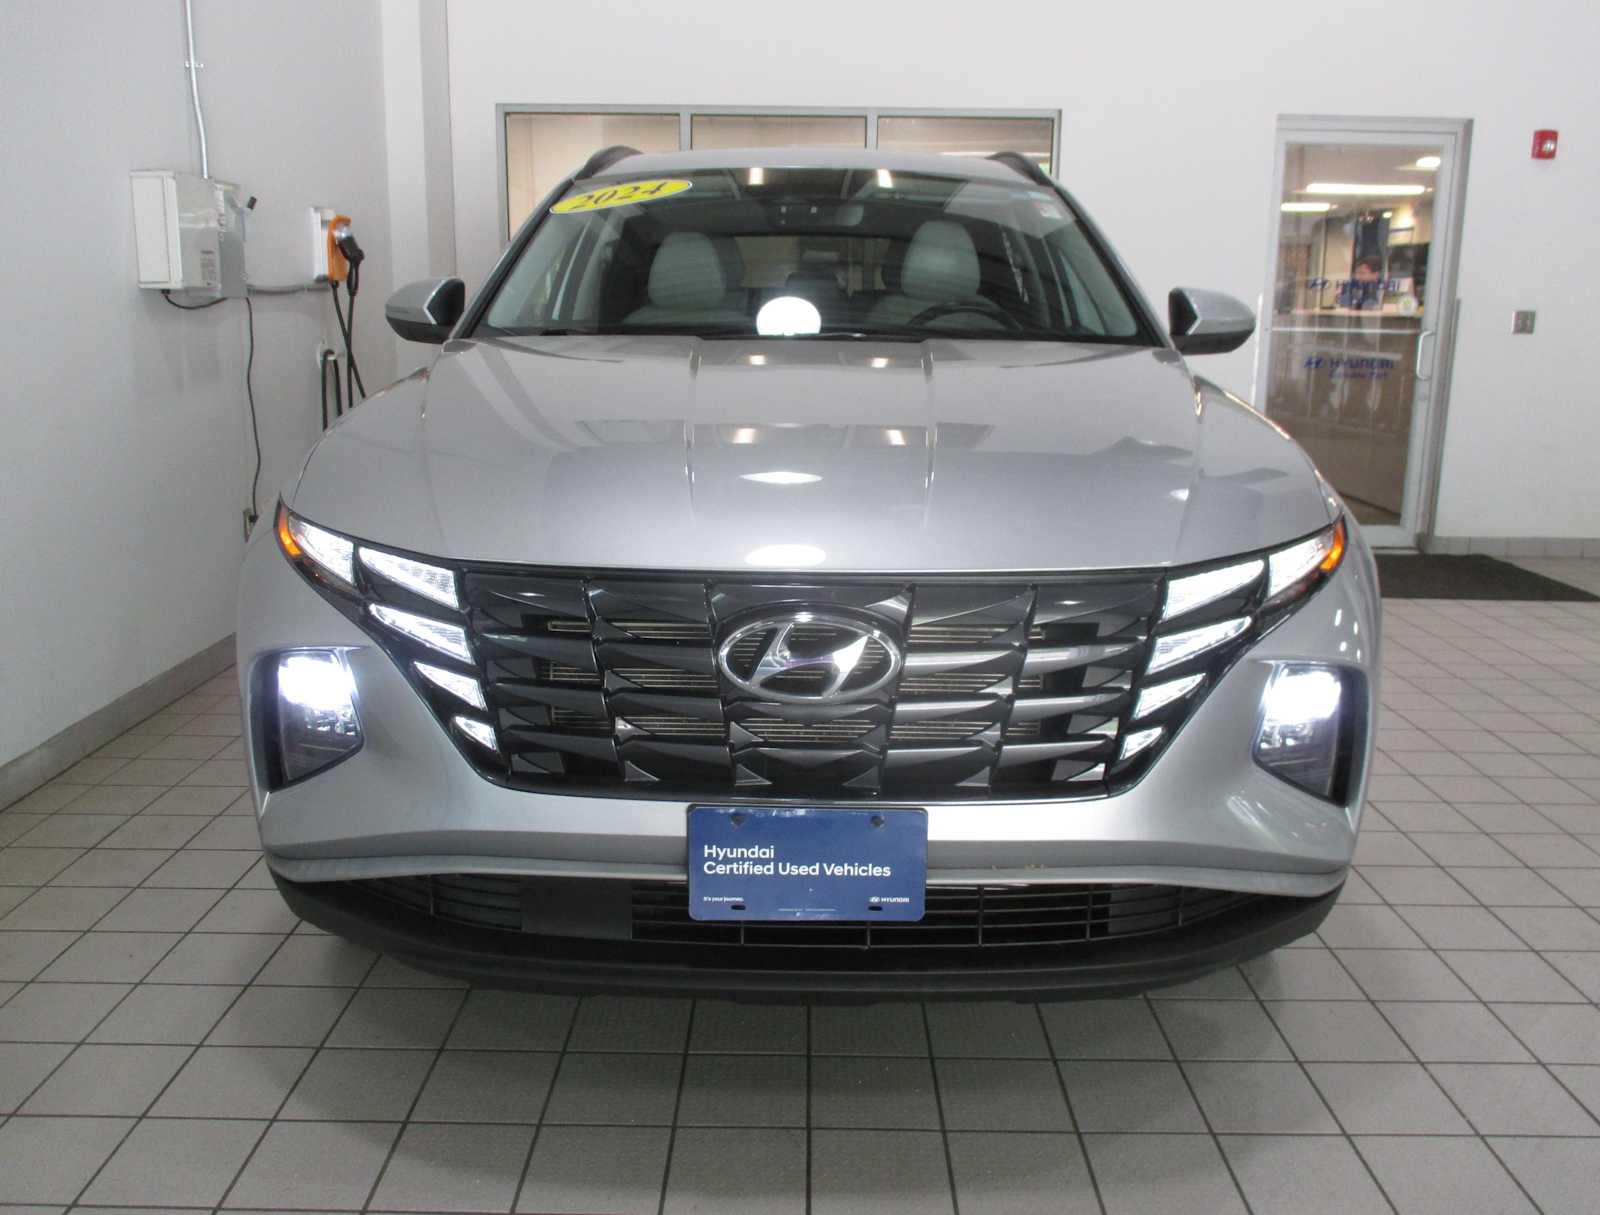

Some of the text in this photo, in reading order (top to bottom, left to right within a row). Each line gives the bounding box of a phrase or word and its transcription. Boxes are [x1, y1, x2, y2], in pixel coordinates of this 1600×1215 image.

[567, 181, 667, 210] 2024
[703, 844, 775, 860] Hyundai
[703, 861, 892, 877] Certified Used Vehicles
